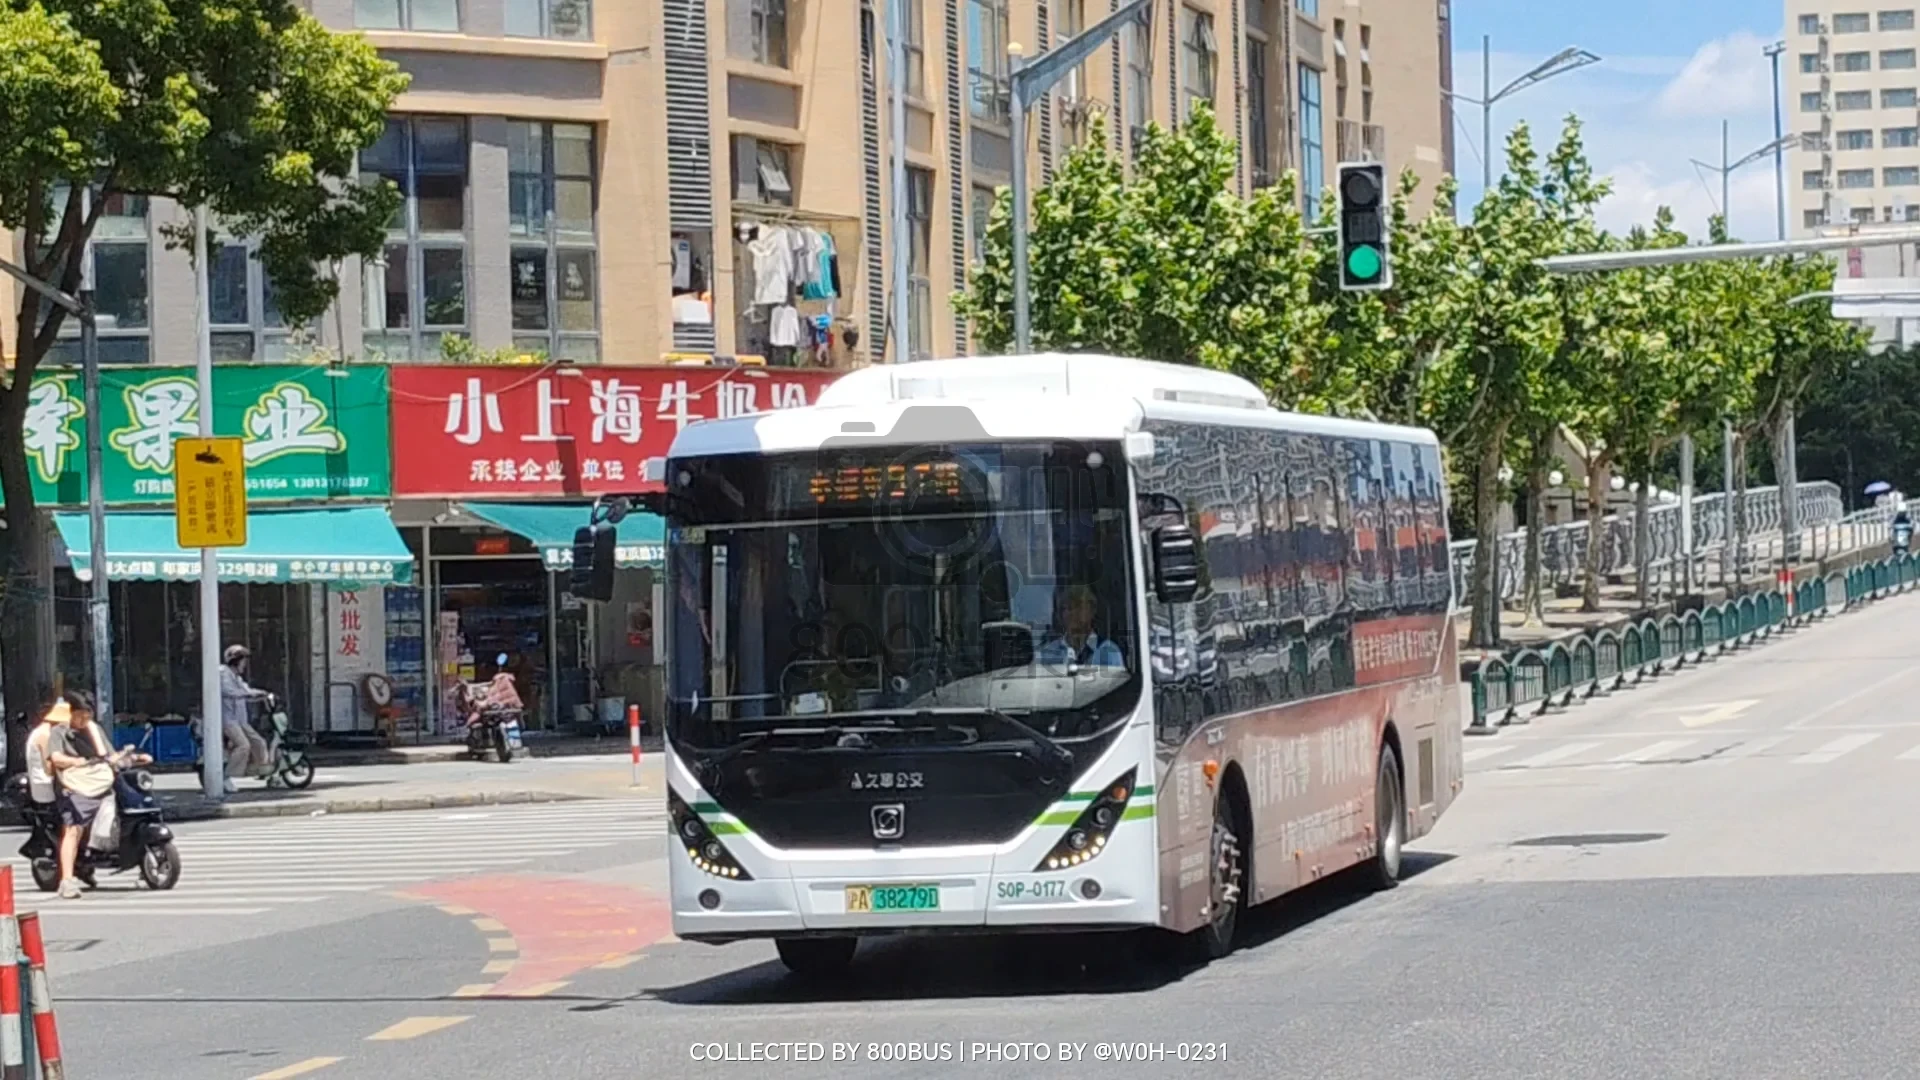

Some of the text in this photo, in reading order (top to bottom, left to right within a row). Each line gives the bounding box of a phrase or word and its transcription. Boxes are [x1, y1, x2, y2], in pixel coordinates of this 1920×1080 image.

[470, 459, 567, 482] 承接企业
[581, 458, 625, 482] 单位
